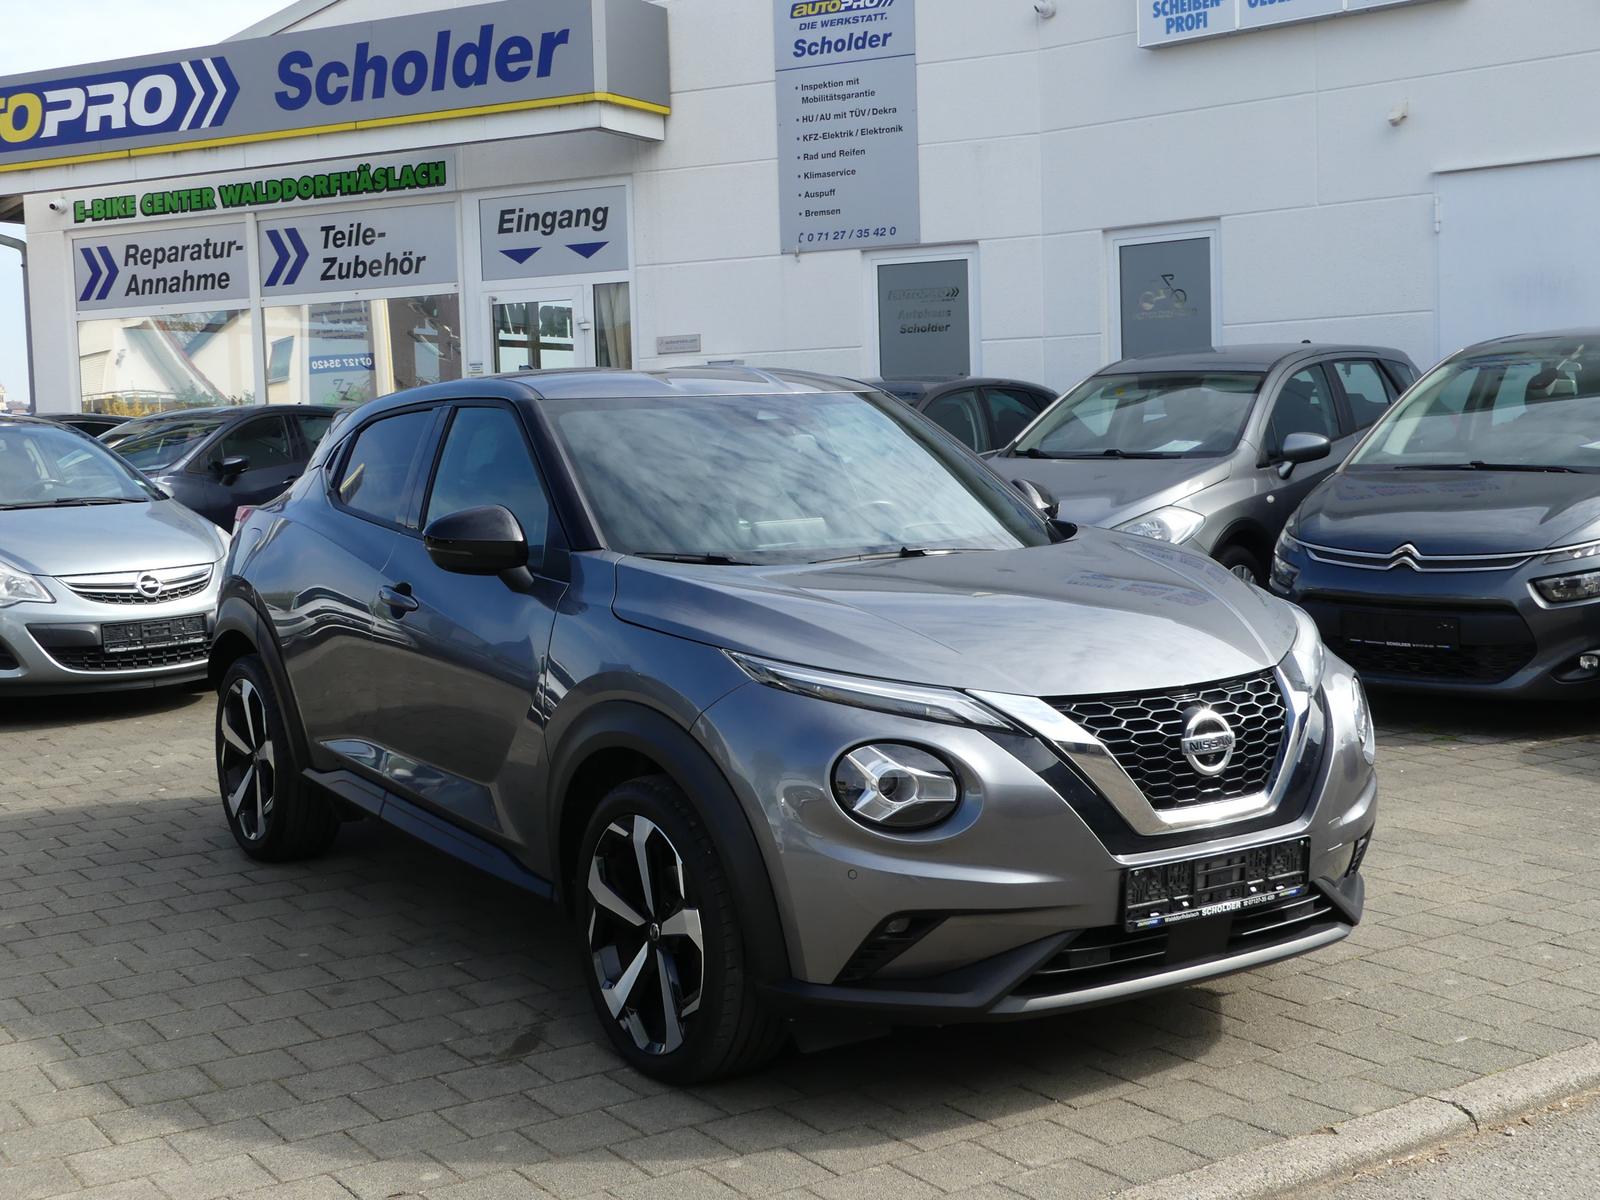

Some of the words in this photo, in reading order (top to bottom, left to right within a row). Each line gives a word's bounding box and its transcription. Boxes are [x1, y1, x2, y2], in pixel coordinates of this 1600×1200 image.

[799, 21, 818, 31] DIE
[820, 12, 888, 28] WERKSTATT.
[1165, 11, 1208, 34] PROFI
[793, 30, 893, 58] Scholder
[275, 23, 570, 111] Scholder
[801, 79, 844, 92] Inspektion
[846, 77, 860, 87] mit
[801, 88, 876, 105] Mobilitätsgarantie
[0, 74, 178, 143] OPRO
[833, 111, 847, 120] mit
[803, 151, 819, 161] Rad
[821, 150, 837, 159] und
[839, 148, 866, 158] Reifen
[803, 168, 857, 180] Klimaservice
[73, 193, 137, 224] E-BIKE
[139, 185, 217, 217] CENTER
[218, 160, 447, 208] WALDDORFHÄSLACH
[804, 188, 836, 199] Auspuff
[497, 206, 609, 236] Eingang
[804, 208, 841, 218] Bremsen
[320, 222, 387, 250] Teile-
[123, 240, 244, 272] Reparatur-
[320, 250, 427, 282] Zubehör
[124, 271, 231, 297] Annahme
[899, 323, 951, 335] Scholder
[1189, 735, 1232, 752] NISSAN
[1201, 901, 1241, 917] SCHOLDER
